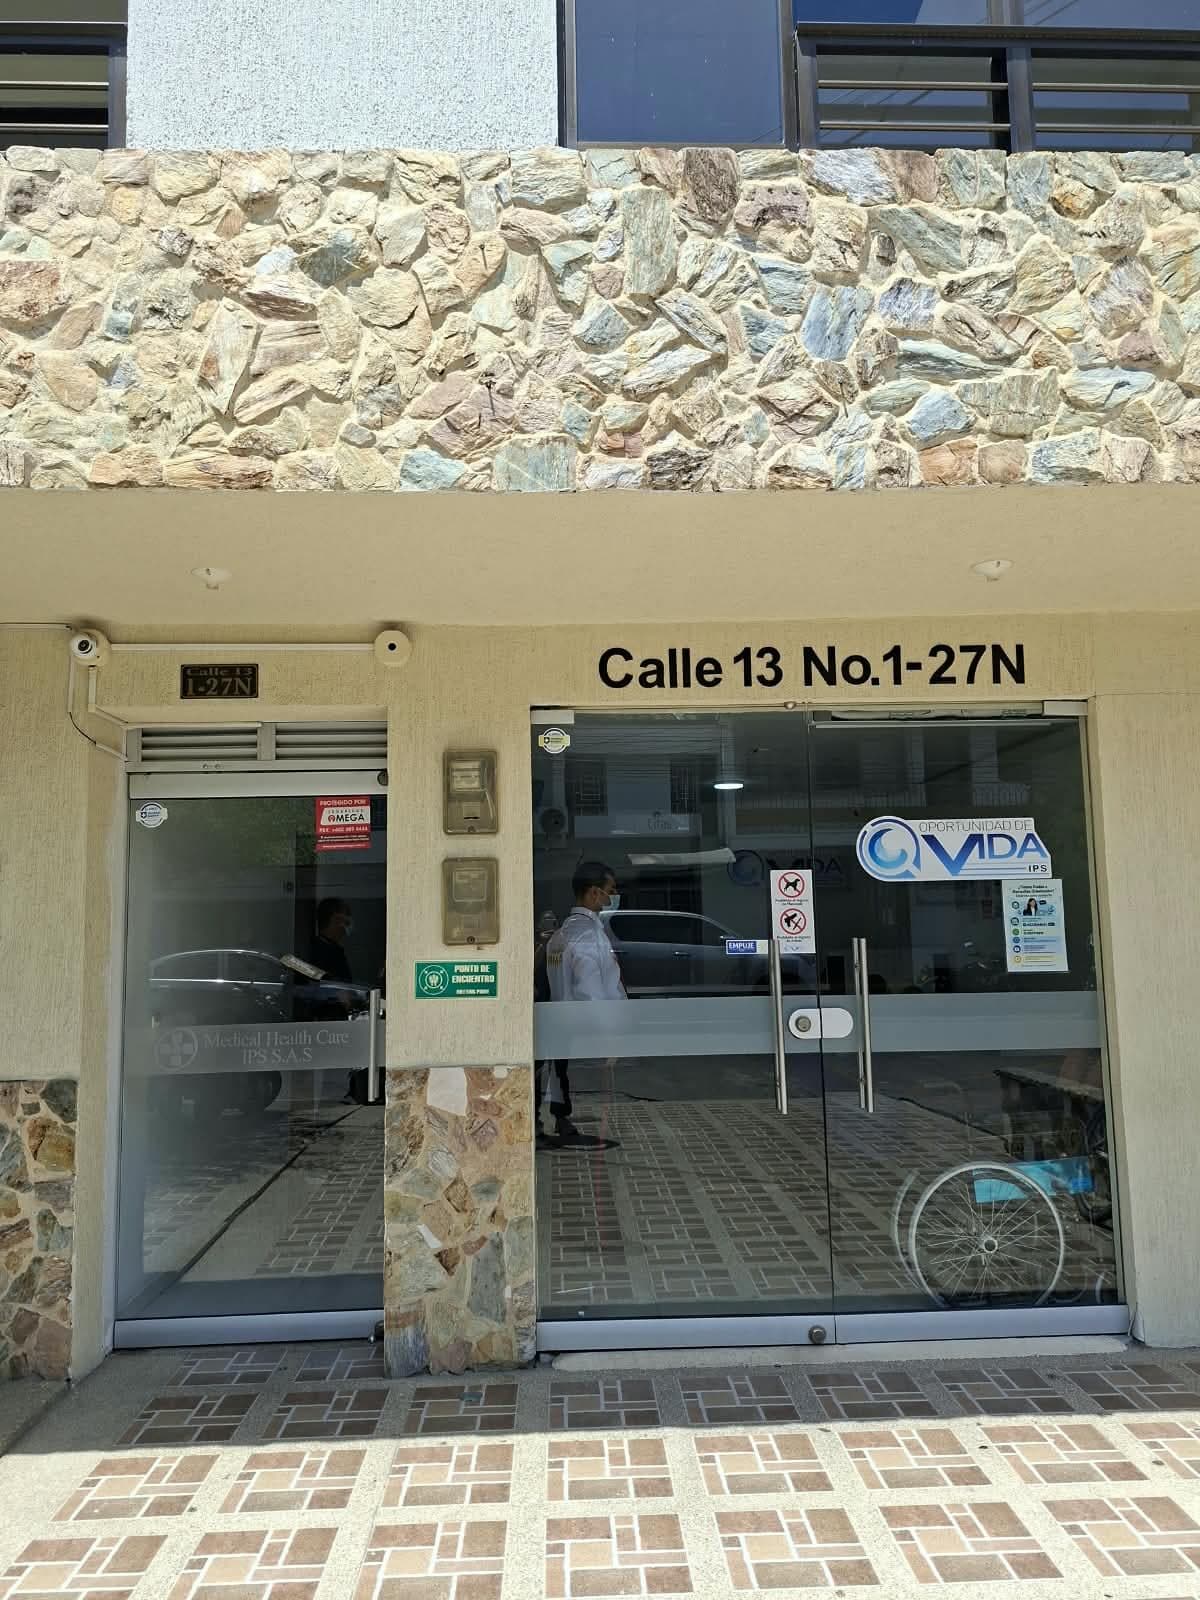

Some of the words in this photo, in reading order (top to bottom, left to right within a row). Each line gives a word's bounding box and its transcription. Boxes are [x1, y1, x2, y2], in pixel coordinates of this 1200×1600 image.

[185, 667, 231, 676] Calle
[598, 647, 723, 689] Calle
[733, 646, 784, 687] 13
[186, 677, 253, 696] 1-27N
[918, 820, 1012, 833] OPORTUNIDAD
[1013, 820, 1034, 832] DE
[920, 832, 1049, 877] VIDA
[1028, 864, 1048, 873] IPS
[454, 965, 479, 973] PUNTO
[480, 965, 490, 973] DE
[452, 975, 495, 983] ENCUENTRO
[204, 1032, 261, 1049] Medical
[265, 1030, 312, 1046] Health
[316, 1029, 349, 1046] Care
[242, 1048, 267, 1065] IPS
[271, 1047, 313, 1064] S.A.S
